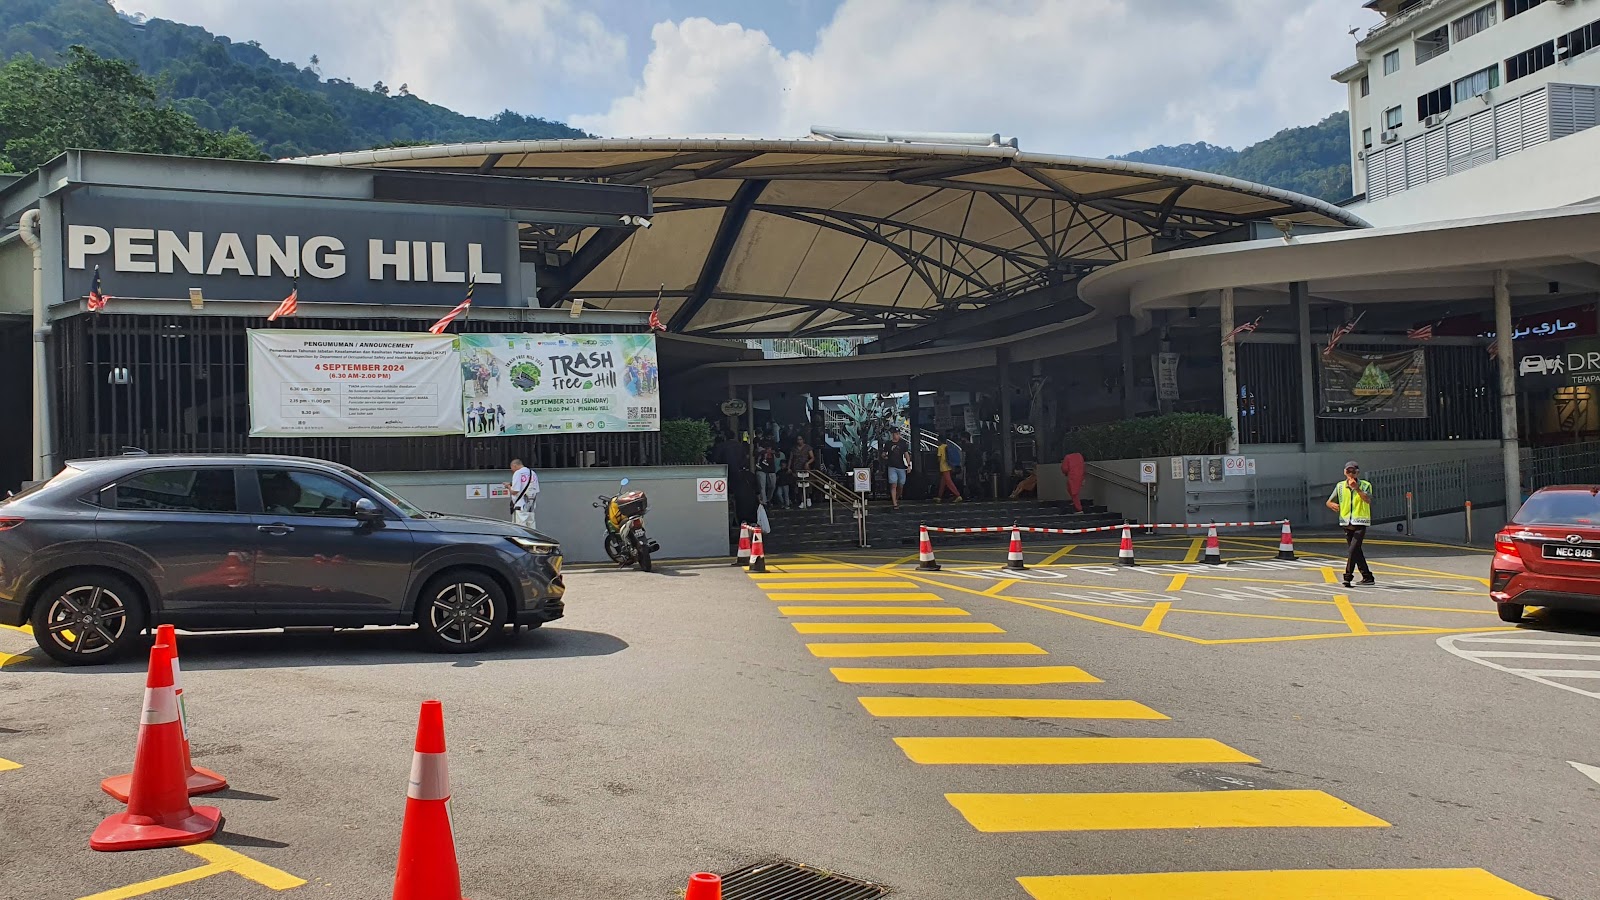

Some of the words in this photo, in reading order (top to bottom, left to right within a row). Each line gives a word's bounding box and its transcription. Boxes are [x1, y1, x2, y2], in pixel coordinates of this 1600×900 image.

[68, 224, 346, 280] PENANG
[368, 238, 502, 284] HILL
[548, 351, 614, 377] TRASH
[1567, 352, 1600, 371] DR
[552, 377, 583, 390] Free
[594, 370, 617, 389] Hill
[1556, 547, 1574, 556] NEC
[1575, 549, 1593, 558] 848
[1049, 591, 1183, 603] NO
